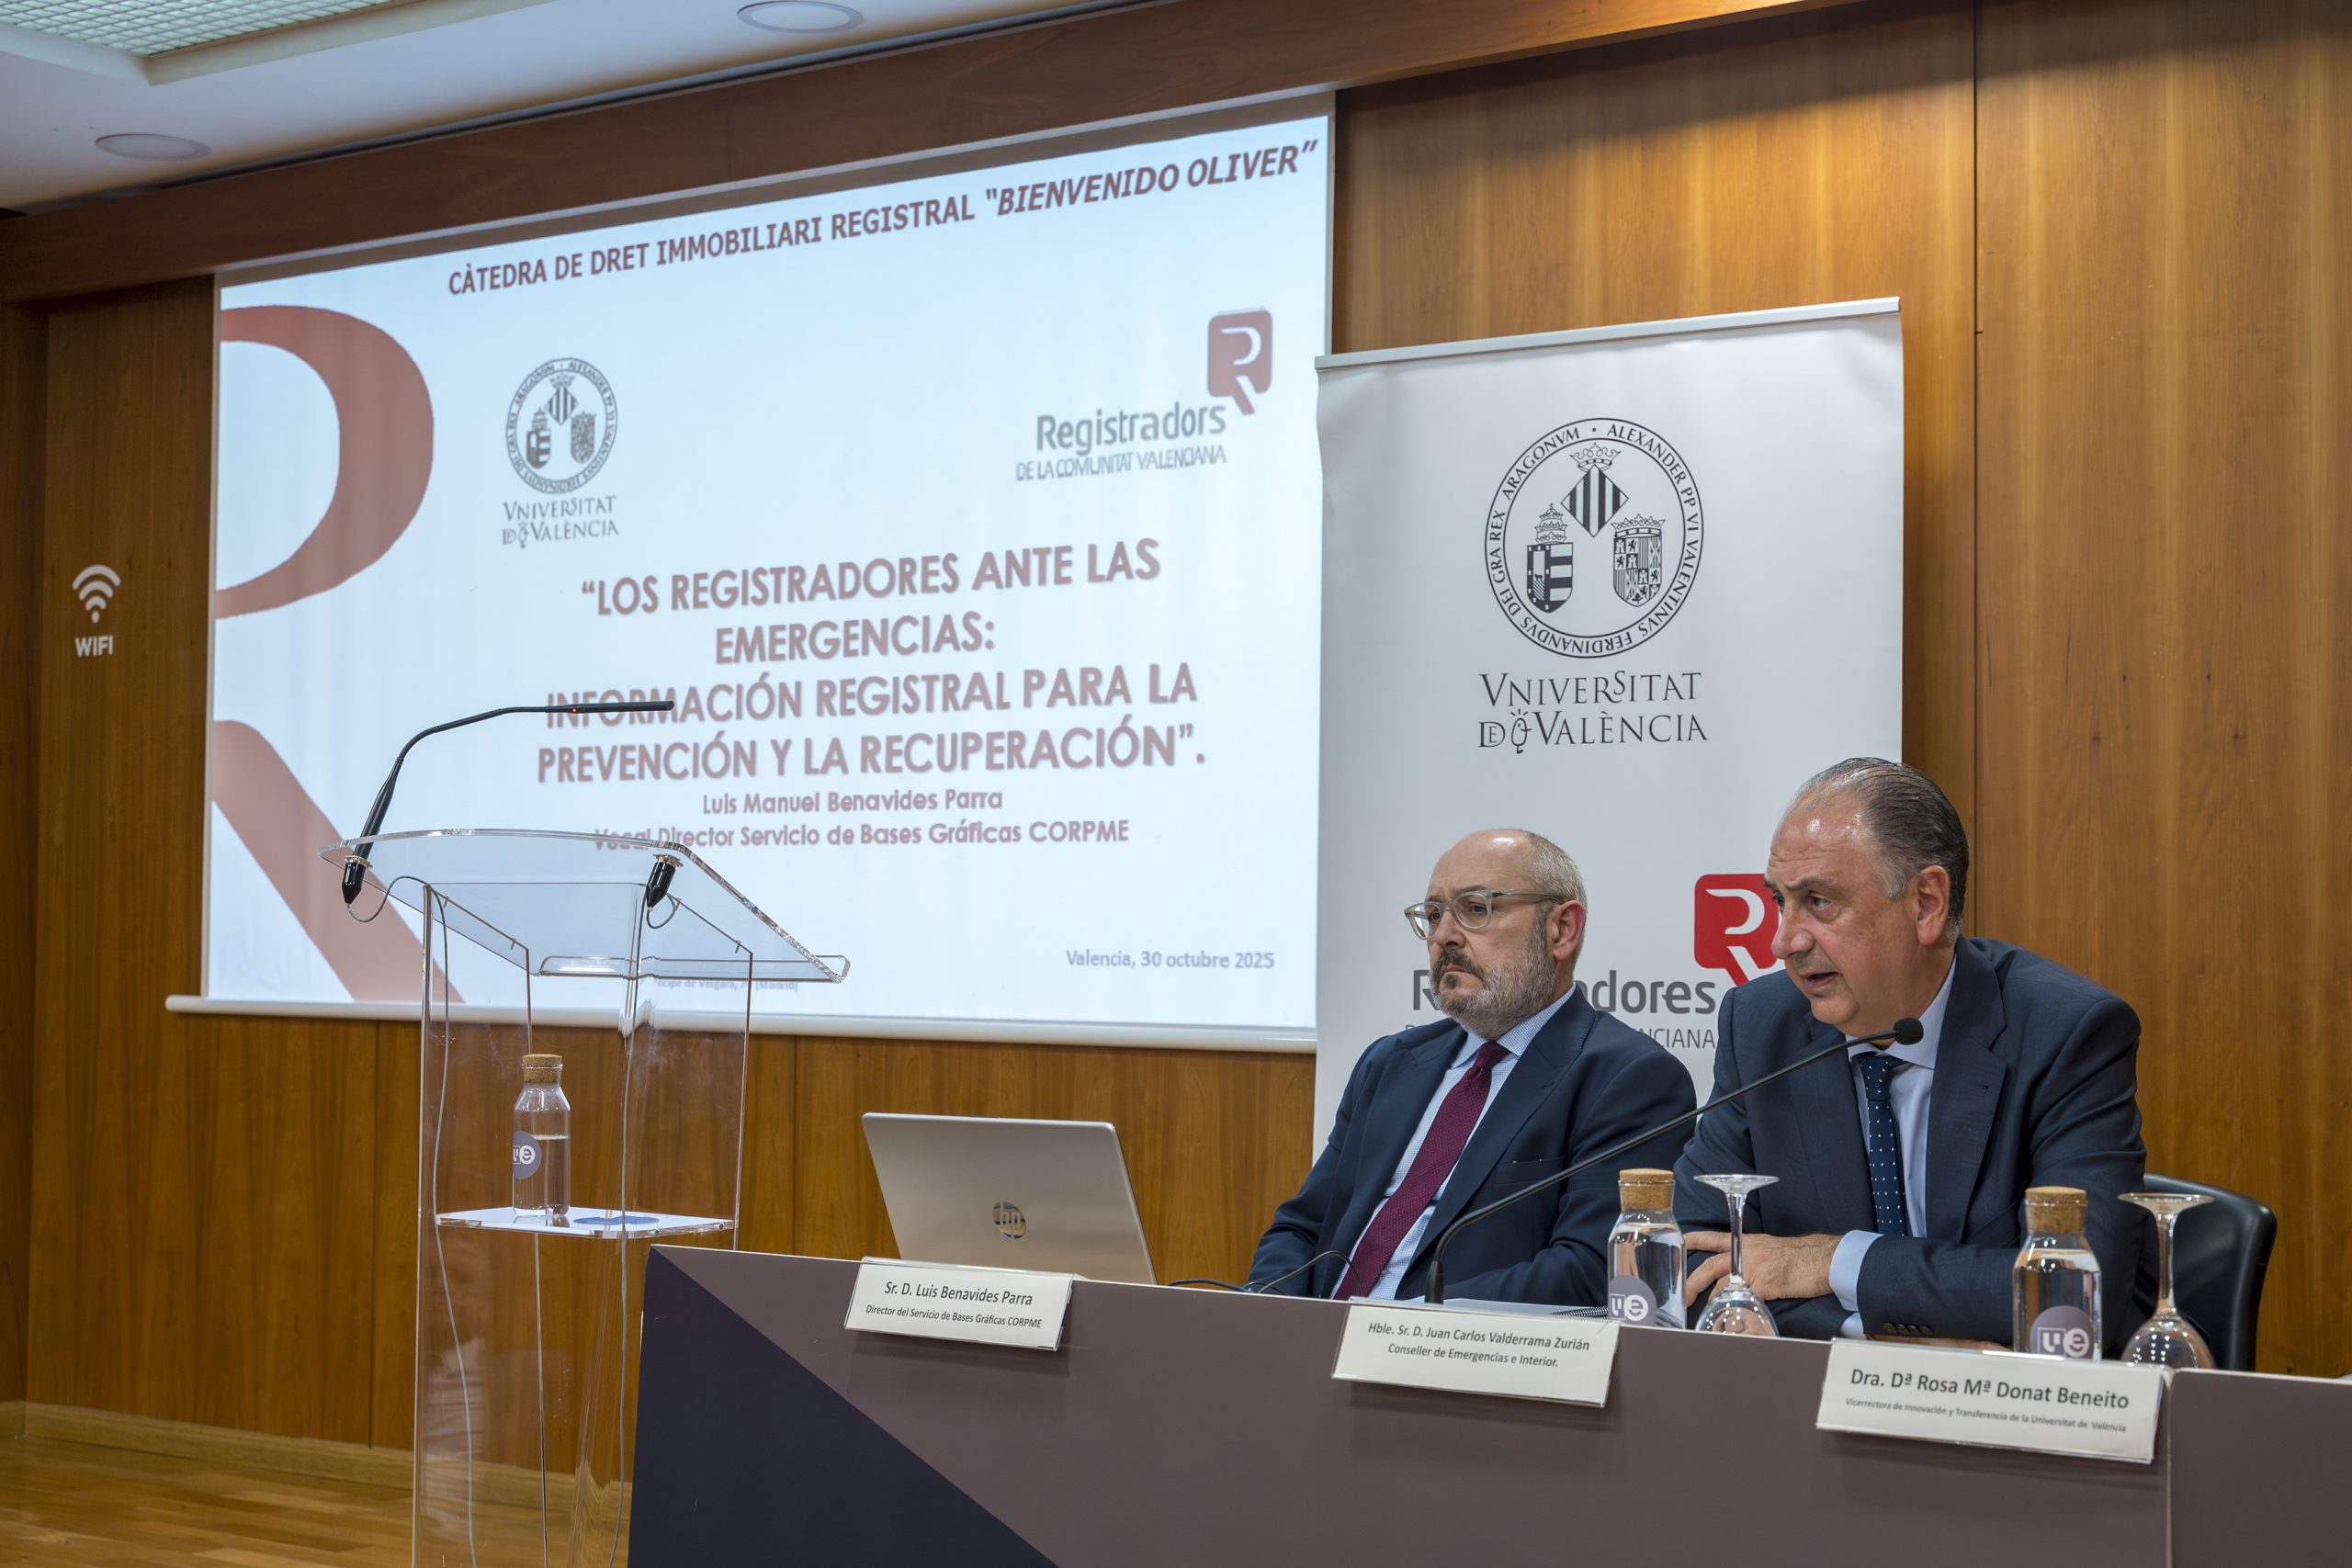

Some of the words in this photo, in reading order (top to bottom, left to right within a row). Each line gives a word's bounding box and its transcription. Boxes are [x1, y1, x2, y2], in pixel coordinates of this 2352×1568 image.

[449, 258, 547, 295] CÀTEDRA
[555, 253, 583, 281] DE
[590, 243, 650, 276] DRET
[657, 217, 822, 265] IMMOBILIARI
[831, 194, 975, 240] REGISTRAL
[1036, 401, 1227, 456] Registradors
[1016, 461, 1034, 481] DE
[1038, 460, 1054, 479] LA
[1056, 452, 1134, 479] COMUNITAT
[1136, 445, 1227, 469] VALENCIANA
[1502, 426, 1581, 501] ARAGONVM
[1606, 423, 1688, 489] ALEXANDER
[1680, 486, 1697, 507] PP
[1488, 510, 1507, 542] REX
[1686, 513, 1700, 532] VI
[582, 575, 658, 616] “LOS
[671, 553, 959, 611] REGISTRADORES
[971, 546, 1073, 591] ANTE
[1088, 538, 1160, 582] LAS
[1488, 547, 1507, 583] GRA
[1500, 589, 1522, 617] DEI
[1637, 539, 1700, 637] VALENTINVS
[74, 635, 114, 658] WIFI
[715, 611, 994, 664] EMERGENCIAS:
[1520, 616, 1634, 654] FERDINANDVS
[547, 671, 801, 728] INFORMACIÓN
[816, 671, 1011, 716] REGISTRAL
[1023, 665, 1132, 708] PARA
[1148, 662, 1197, 704] LA
[1478, 670, 1702, 706] VNIVERSITAT
[1532, 710, 1709, 746] VALÈNCIA
[537, 730, 756, 783] PREVENCIÓN
[770, 739, 792, 776] Y
[804, 738, 849, 775] LA
[703, 793, 737, 815] Luis
[743, 792, 820, 814] Manuel
[828, 789, 938, 812] Benavides
[945, 788, 1003, 810] Parra
[658, 826, 735, 847] Director
[740, 825, 820, 846] Servicio
[827, 825, 854, 845] de
[860, 824, 922, 845] Bases
[928, 818, 1023, 844] Gráficas
[1028, 818, 1129, 842] CORPME
[1066, 948, 1136, 969] Valencia,
[1140, 952, 1163, 967] 30
[1166, 950, 1231, 968] octubre
[1234, 952, 1275, 969] 2025
[884, 1280, 899, 1294] Sr.
[900, 1282, 912, 1296] D.
[915, 1283, 939, 1299] Luis
[940, 1286, 1000, 1303] Benavides
[1001, 1291, 1034, 1305] Parra
[865, 1304, 896, 1315] Director
[897, 1307, 910, 1317] del
[910, 1308, 940, 1320] Servicio
[941, 1311, 951, 1321] de
[952, 1312, 974, 1323] Bases
[975, 1313, 1006, 1325] Gráficas
[1007, 1316, 1043, 1328] CORPME
[1368, 1322, 1395, 1336] Hble.
[1397, 1325, 1410, 1337] Sr.
[1413, 1325, 1424, 1337] D.
[1425, 1326, 1451, 1340] Juan
[1453, 1328, 1486, 1343] Carlos
[1488, 1331, 1552, 1348] Valderrama
[1554, 1337, 1589, 1352] Zurián
[1387, 1342, 1431, 1357] Conseller
[1433, 1347, 1446, 1358] de
[1448, 1348, 1509, 1364] Emergencias
[1510, 1355, 1518, 1364] e
[1519, 1353, 1559, 1368] Interior.
[1850, 1368, 1884, 1387] Dra.
[1890, 1371, 1913, 1389] Dª
[1917, 1374, 1958, 1394] Rosa
[1963, 1378, 1992, 1396] Mª
[1996, 1382, 2052, 1402] Donat
[2057, 1386, 2130, 1410] Beneito
[1845, 1397, 1891, 1410] Vicerrectora
[1893, 1402, 1903, 1411] de
[1905, 1403, 1946, 1416] Innovación
[1949, 1409, 1953, 1417] y
[1955, 1407, 2007, 1421] Transferencia
[2009, 1413, 2019, 1422] de
[2021, 1414, 2029, 1423] la
[2030, 1416, 2076, 1428] Universitat
[2077, 1420, 2087, 1429] de
